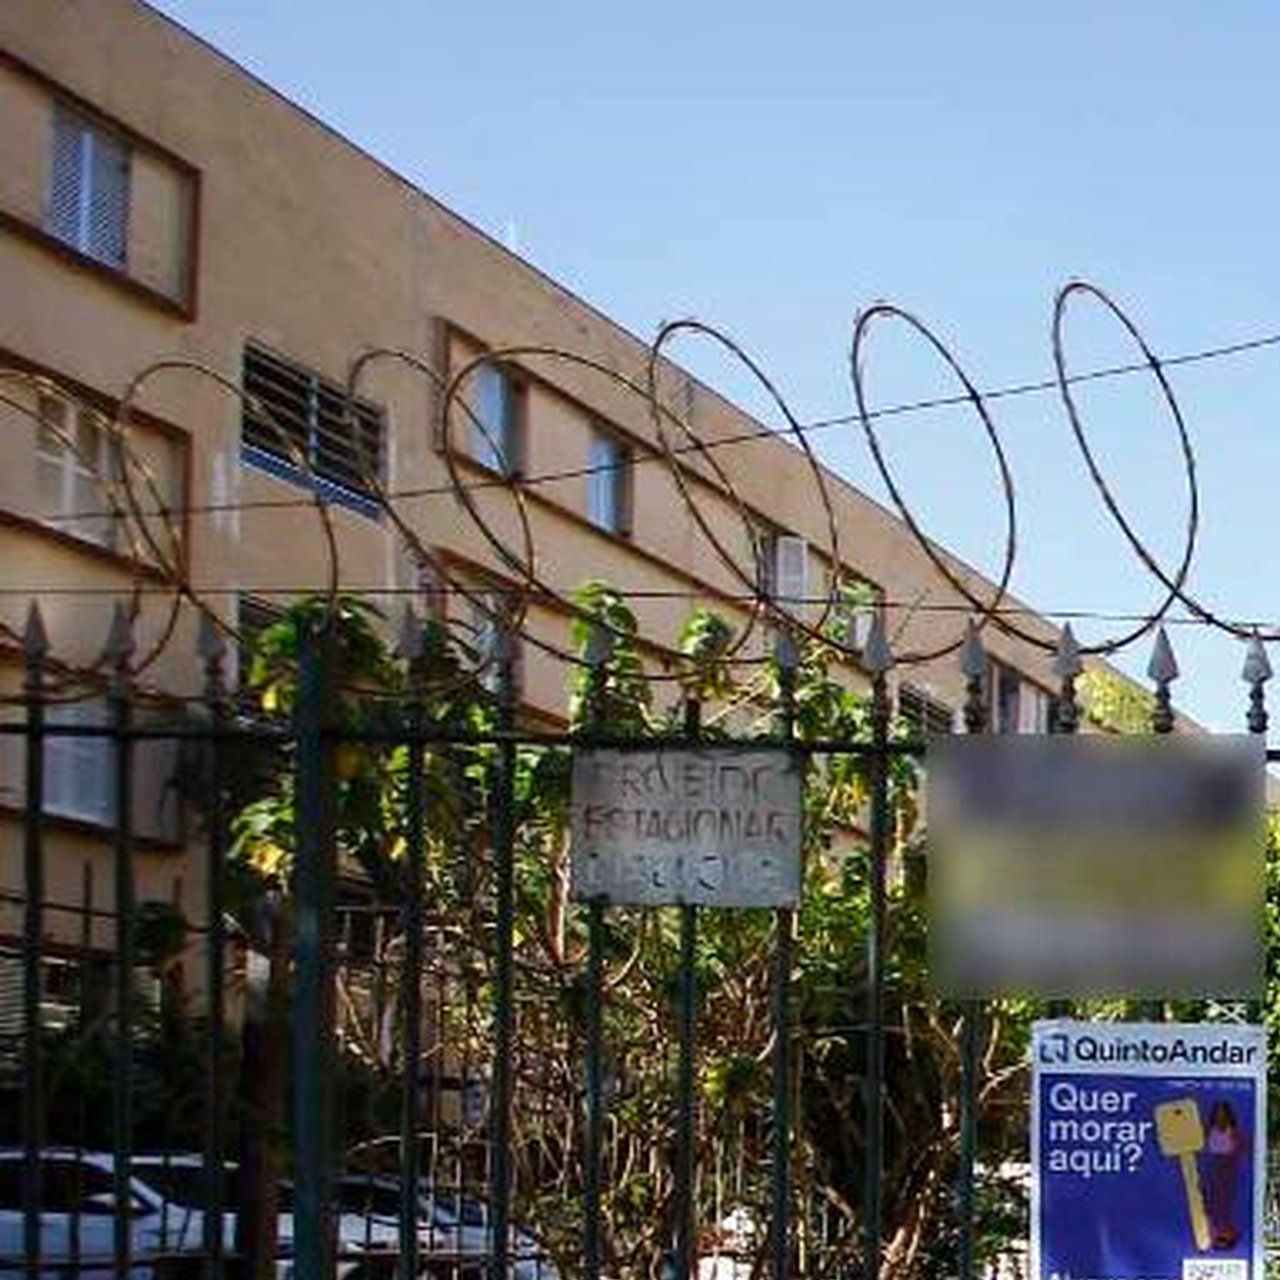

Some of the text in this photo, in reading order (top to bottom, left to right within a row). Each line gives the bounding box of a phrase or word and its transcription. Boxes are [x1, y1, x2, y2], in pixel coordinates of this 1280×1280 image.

[1074, 1036, 1258, 1065] QuintoAndar
[1049, 1083, 1138, 1113] Quer
[1049, 1119, 1153, 1143] morar
[1049, 1143, 1143, 1178] aqui?
